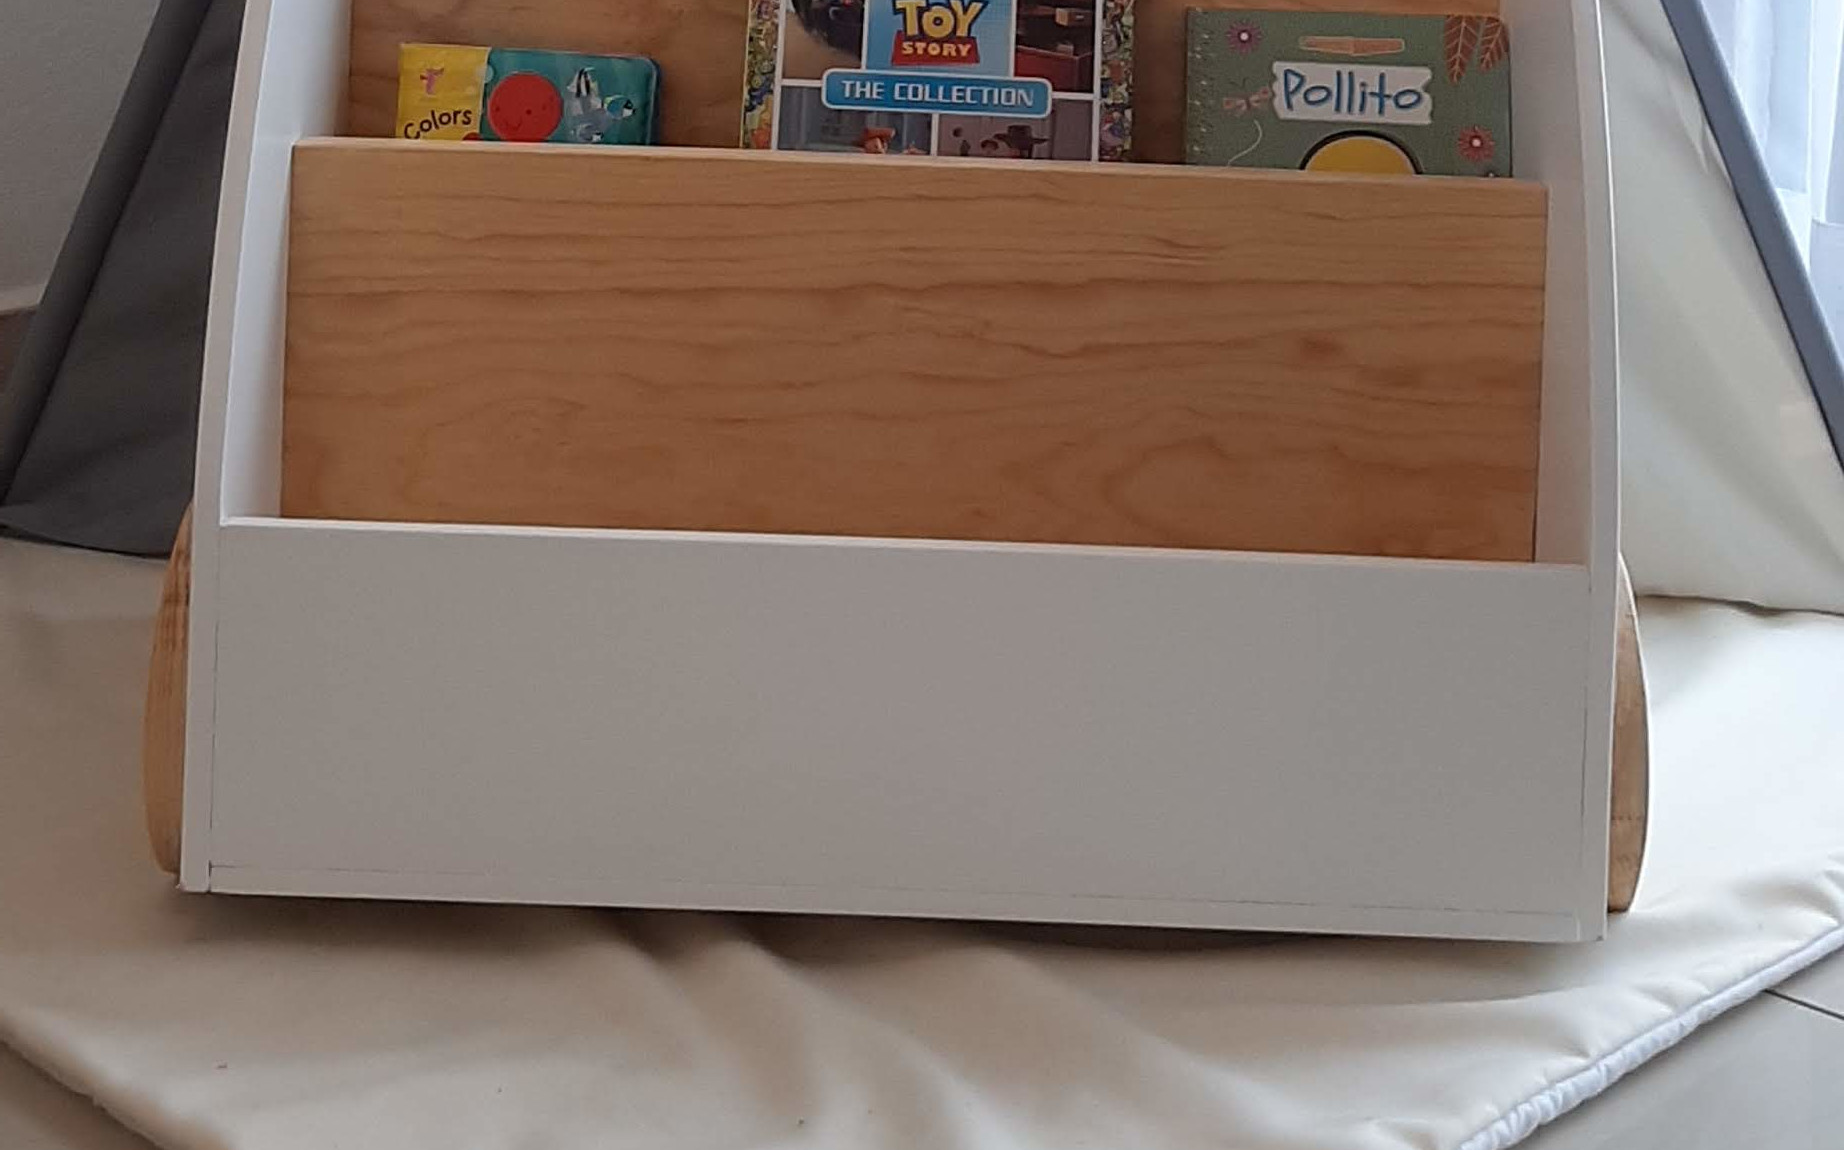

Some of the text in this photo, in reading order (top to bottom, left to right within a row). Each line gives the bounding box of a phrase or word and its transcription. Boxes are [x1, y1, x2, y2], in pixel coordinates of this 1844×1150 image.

[901, 41, 972, 57] STORY
[841, 79, 1034, 107] THE COLLECTION
[1282, 67, 1422, 116] Pollito
[404, 109, 473, 139] Colors
